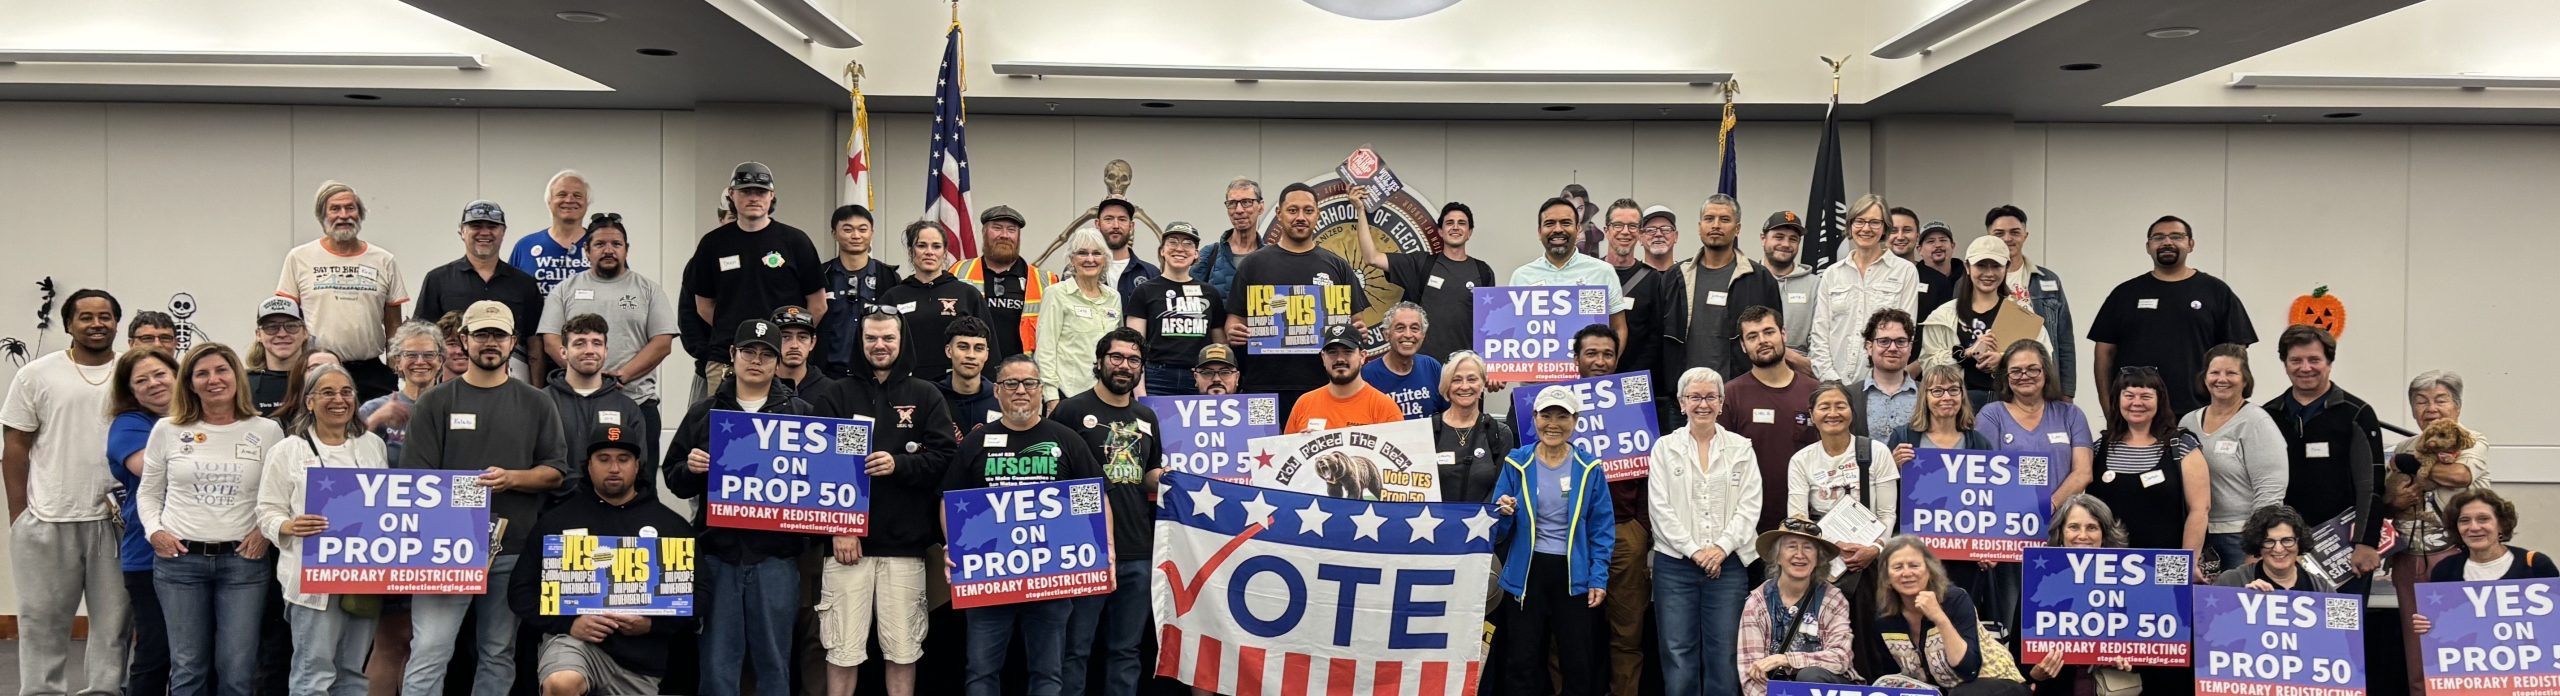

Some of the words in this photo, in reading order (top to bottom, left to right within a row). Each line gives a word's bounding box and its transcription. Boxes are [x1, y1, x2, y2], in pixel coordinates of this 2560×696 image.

[1316, 226, 1344, 246] ANIZED
[1373, 208, 1392, 226] OF
[1390, 221, 1420, 255] ELECT
[1247, 285, 1275, 316] YES
[1286, 295, 1316, 326] YES
[1508, 290, 1572, 316] YES
[1526, 320, 1556, 335] ON
[1484, 338, 1560, 359] PROP
[1486, 362, 1534, 373] MPORARY
[1537, 362, 1580, 374] REDISTRI
[1174, 399, 1241, 428] YES
[1400, 402, 1423, 415] ll&
[1574, 414, 1604, 433] ON
[752, 418, 828, 454] YES
[1194, 432, 1224, 448] ON
[1618, 430, 1650, 454] 50
[1350, 432, 1377, 450] The
[1380, 442, 1412, 470] Bear
[194, 462, 242, 472] VOTE
[772, 456, 808, 476] ON
[985, 456, 1058, 476] AFSCME
[1236, 452, 1250, 474] 5
[1940, 454, 2011, 486] YES
[194, 472, 242, 483] VOTE
[1383, 470, 1408, 486] Vote
[1412, 472, 1432, 488] YES
[194, 484, 240, 495] VOTE
[356, 473, 442, 508] YES
[722, 474, 811, 504] PROP
[818, 482, 857, 508] 50
[1408, 492, 1425, 502] 50
[1960, 489, 1993, 506] ON
[194, 495, 236, 505] VOTE
[986, 487, 1062, 524] YES
[379, 512, 419, 532] ON
[710, 503, 780, 520] TEMPORARY
[783, 508, 865, 526] REDISTRICTING
[1914, 508, 1998, 534] PROP
[2004, 513, 2040, 536] 50
[622, 536, 638, 548] VOTE
[1011, 524, 1046, 545] ON
[318, 536, 422, 564] PROP
[431, 538, 474, 564] 50
[562, 536, 598, 570] YES
[612, 548, 650, 582] YES
[962, 546, 1052, 580] PROP
[1060, 543, 1097, 570] 50
[2066, 552, 2146, 586] YES
[305, 569, 387, 582] TEMPORARY
[392, 570, 484, 582] REDISTRICTING
[570, 571, 587, 582] PROP
[587, 571, 596, 582] 50
[665, 571, 673, 582] ON
[674, 571, 690, 582] PROP
[954, 580, 1024, 598] TEMPORARY
[1027, 571, 1108, 590] REDISTRICTING
[561, 582, 588, 594] OVEMBER
[589, 582, 601, 594] 4TH
[614, 582, 622, 594] ON
[623, 582, 639, 594] PROP
[640, 582, 647, 593] 50
[609, 594, 640, 606] NOVEMBER
[640, 593, 652, 605] 4TH
[2088, 590, 2125, 608] ON
[2462, 583, 2554, 618] YES
[2237, 592, 2318, 628] YES
[2036, 611, 2129, 637] PROP
[2136, 613, 2177, 638] 50
[2493, 622, 2534, 640] ON
[2026, 640, 2096, 653] TEMPORARY
[2100, 642, 2187, 656] REDISTRICTING
[2261, 631, 2297, 650] ON
[2209, 650, 2303, 680] PROP
[2312, 658, 2351, 684] 50
[2437, 645, 2542, 672] PROP
[2200, 680, 2274, 696] TEMPORARY
[2430, 677, 2508, 689] TEMPORARY
